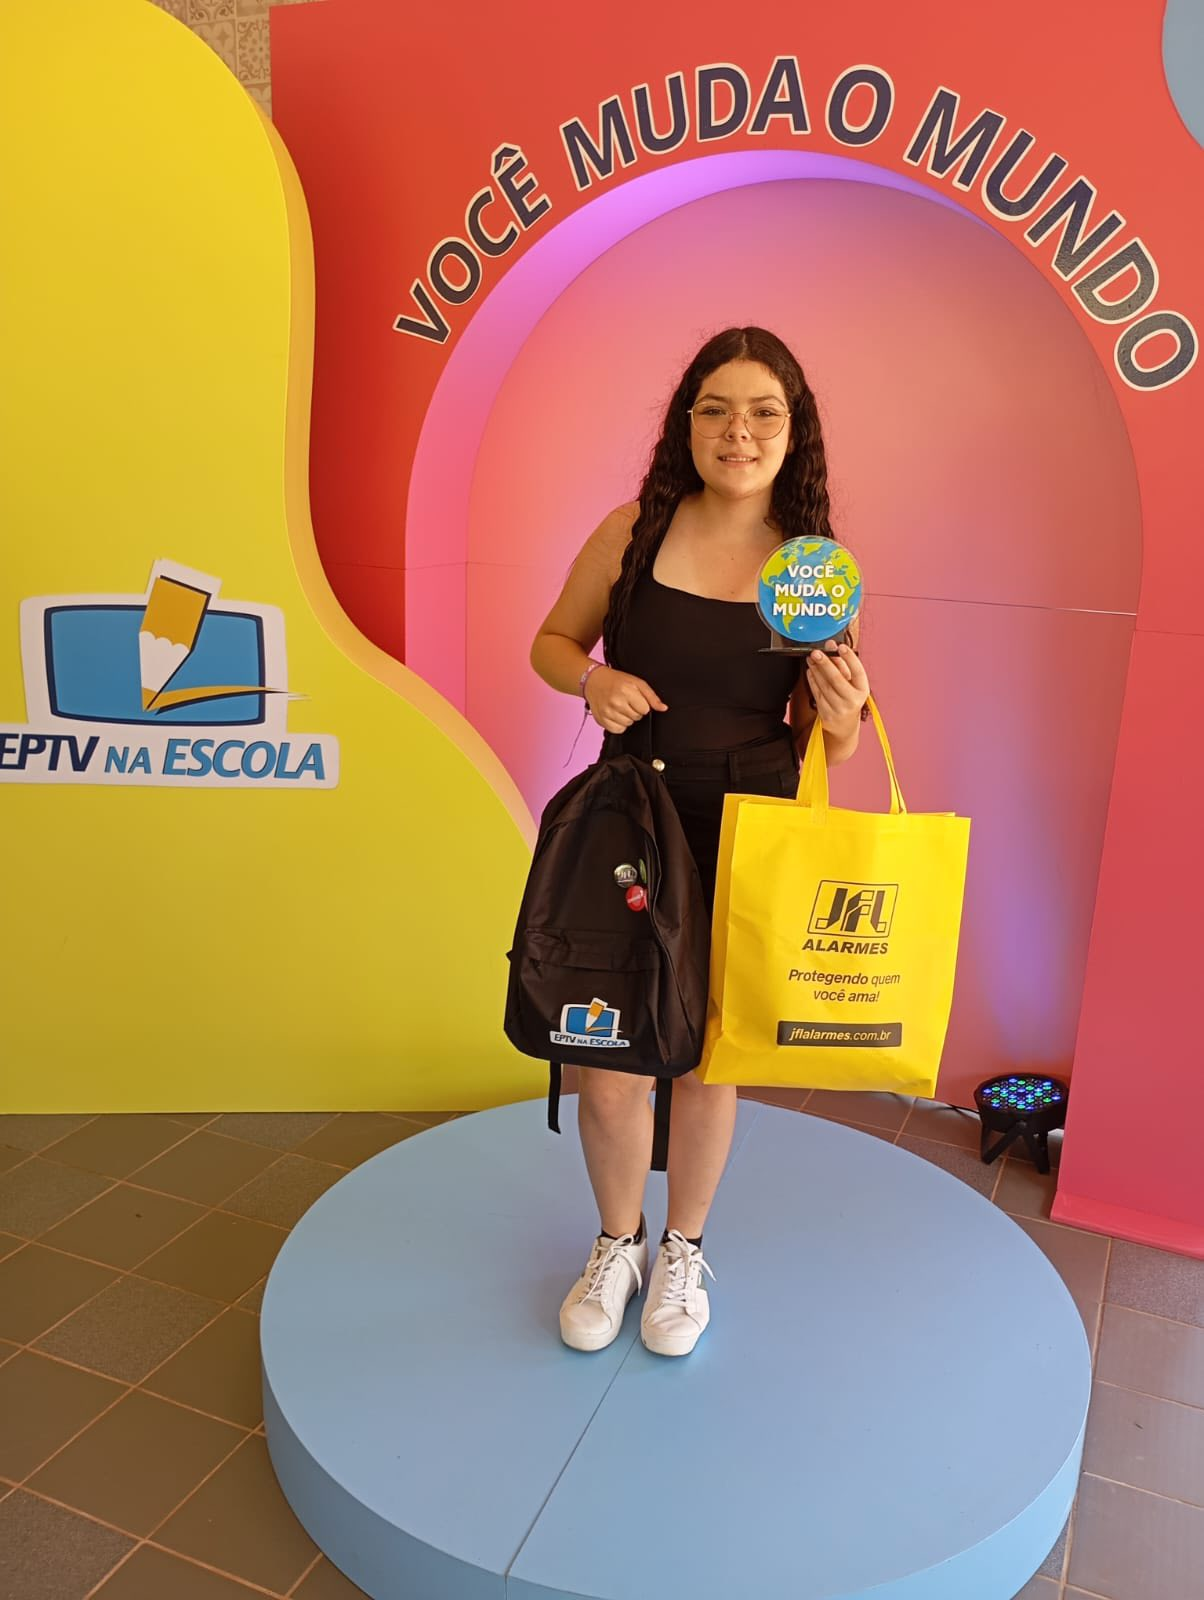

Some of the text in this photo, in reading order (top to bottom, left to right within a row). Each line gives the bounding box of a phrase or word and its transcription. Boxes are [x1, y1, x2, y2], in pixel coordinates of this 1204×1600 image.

[393, 55, 1199, 391] VOCÊ MUDA O MUNDO
[787, 561, 835, 578] VOCÊ
[775, 584, 845, 597] MUDA O
[773, 603, 847, 616] MUNDO!
[0, 733, 325, 780] EPTV NA ESCOLA
[802, 939, 889, 955] ALARMES
[788, 969, 900, 987] Protegendo quem
[813, 989, 880, 1003] você ama!
[554, 1033, 576, 1043] EPTV
[589, 1038, 626, 1047] ESCOLA
[789, 1027, 891, 1041] jflalarmes.com.br
